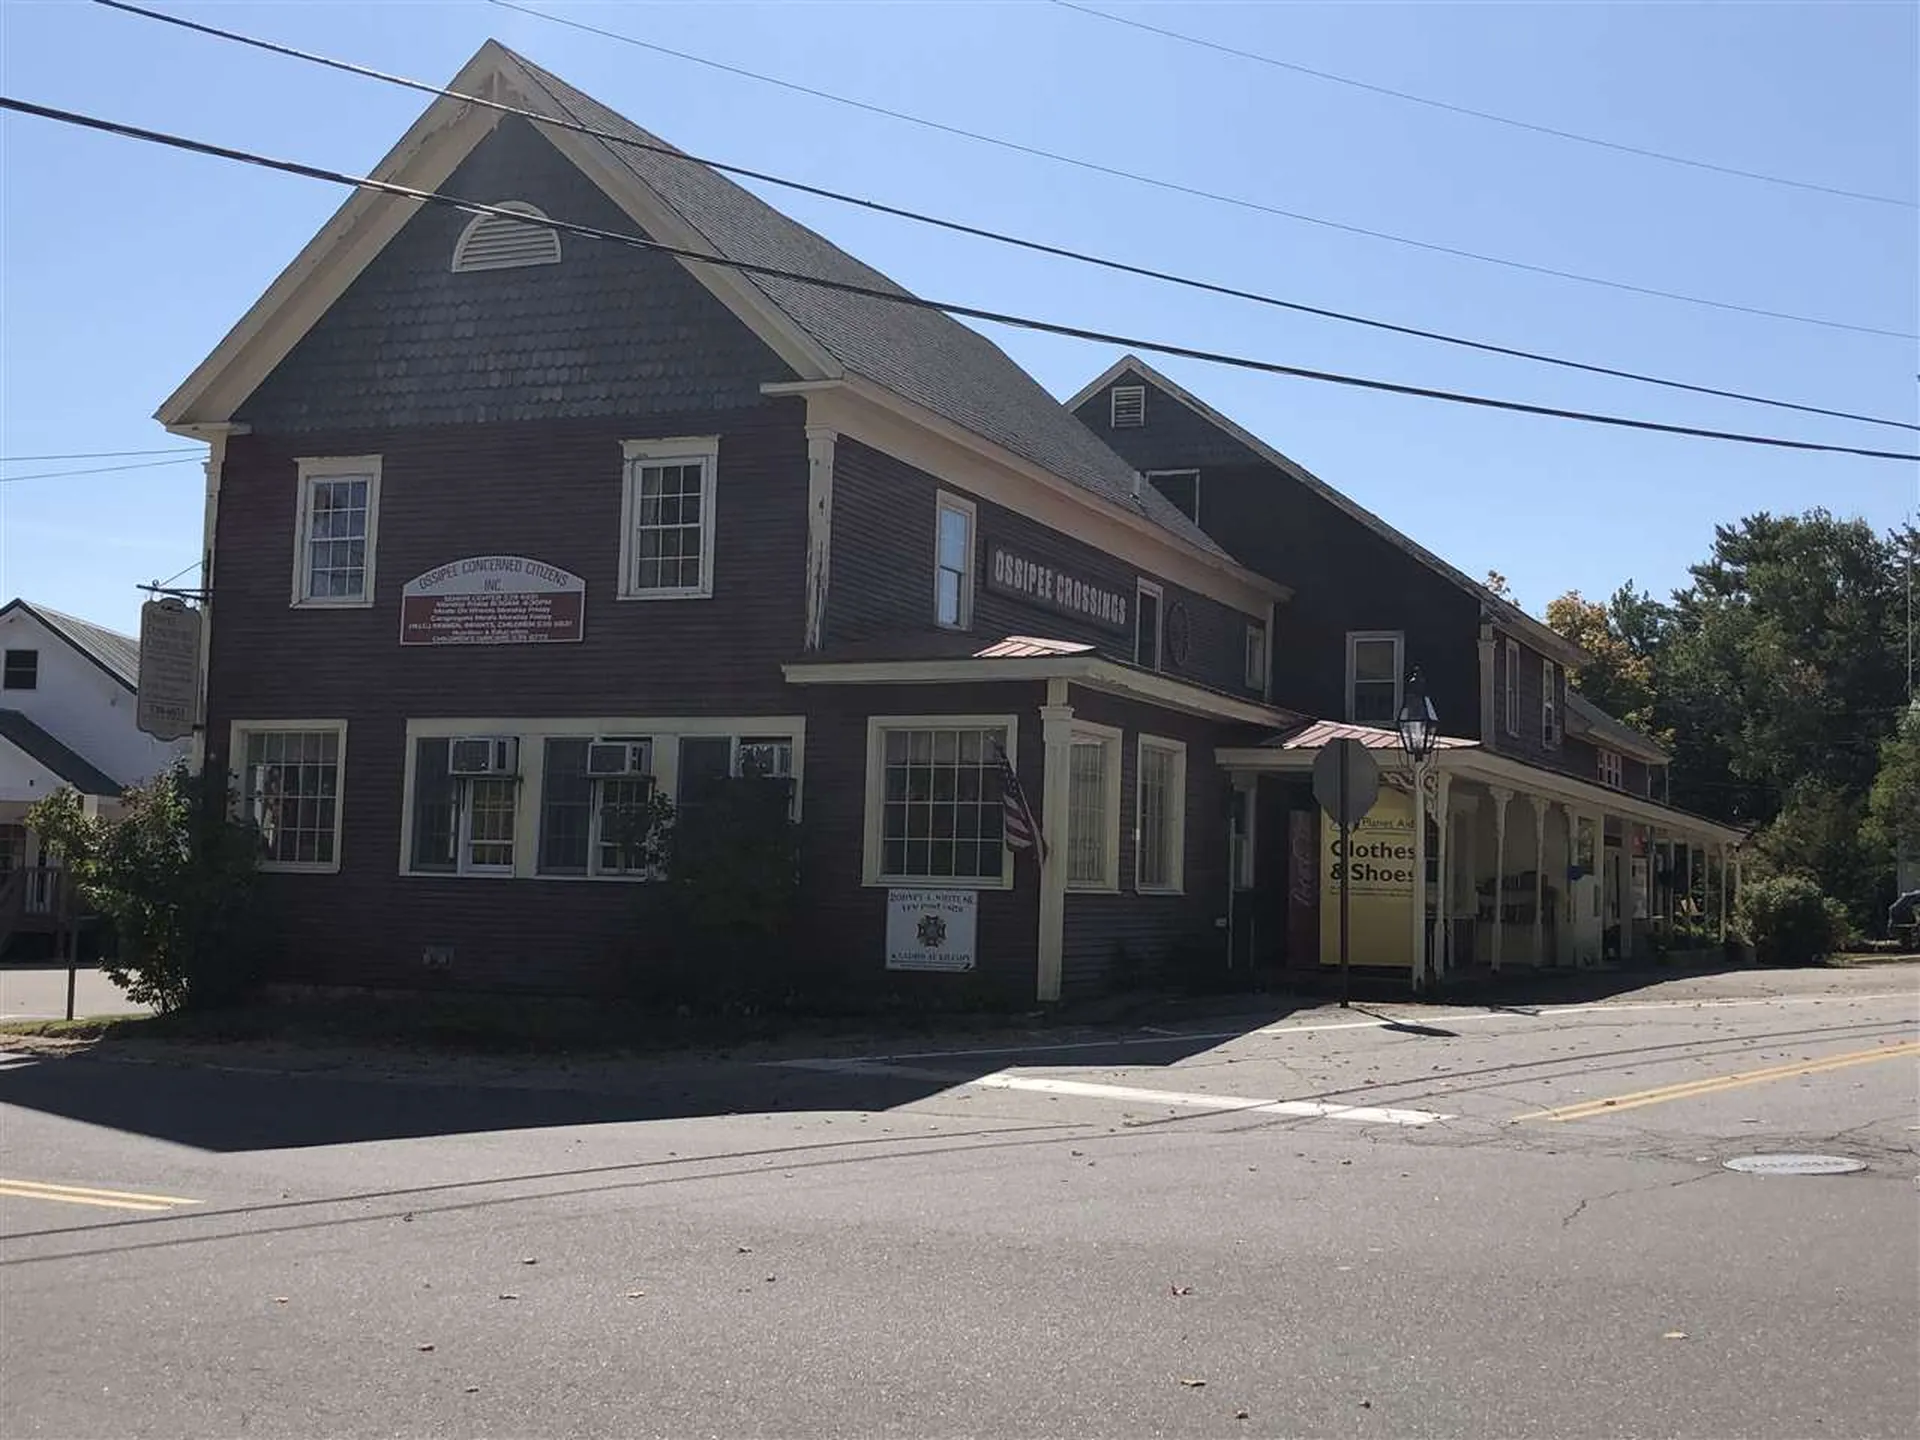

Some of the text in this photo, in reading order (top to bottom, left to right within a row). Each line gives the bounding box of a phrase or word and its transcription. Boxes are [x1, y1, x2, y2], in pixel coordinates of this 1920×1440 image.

[419, 557, 569, 590] OSSIPEE CONCERNED CITIZENS
[484, 578, 504, 592] INC.
[995, 549, 1126, 625] OSSIPEE CROSSINGS
[1330, 840, 1415, 860] Clothes
[1351, 863, 1414, 882] Shoes
